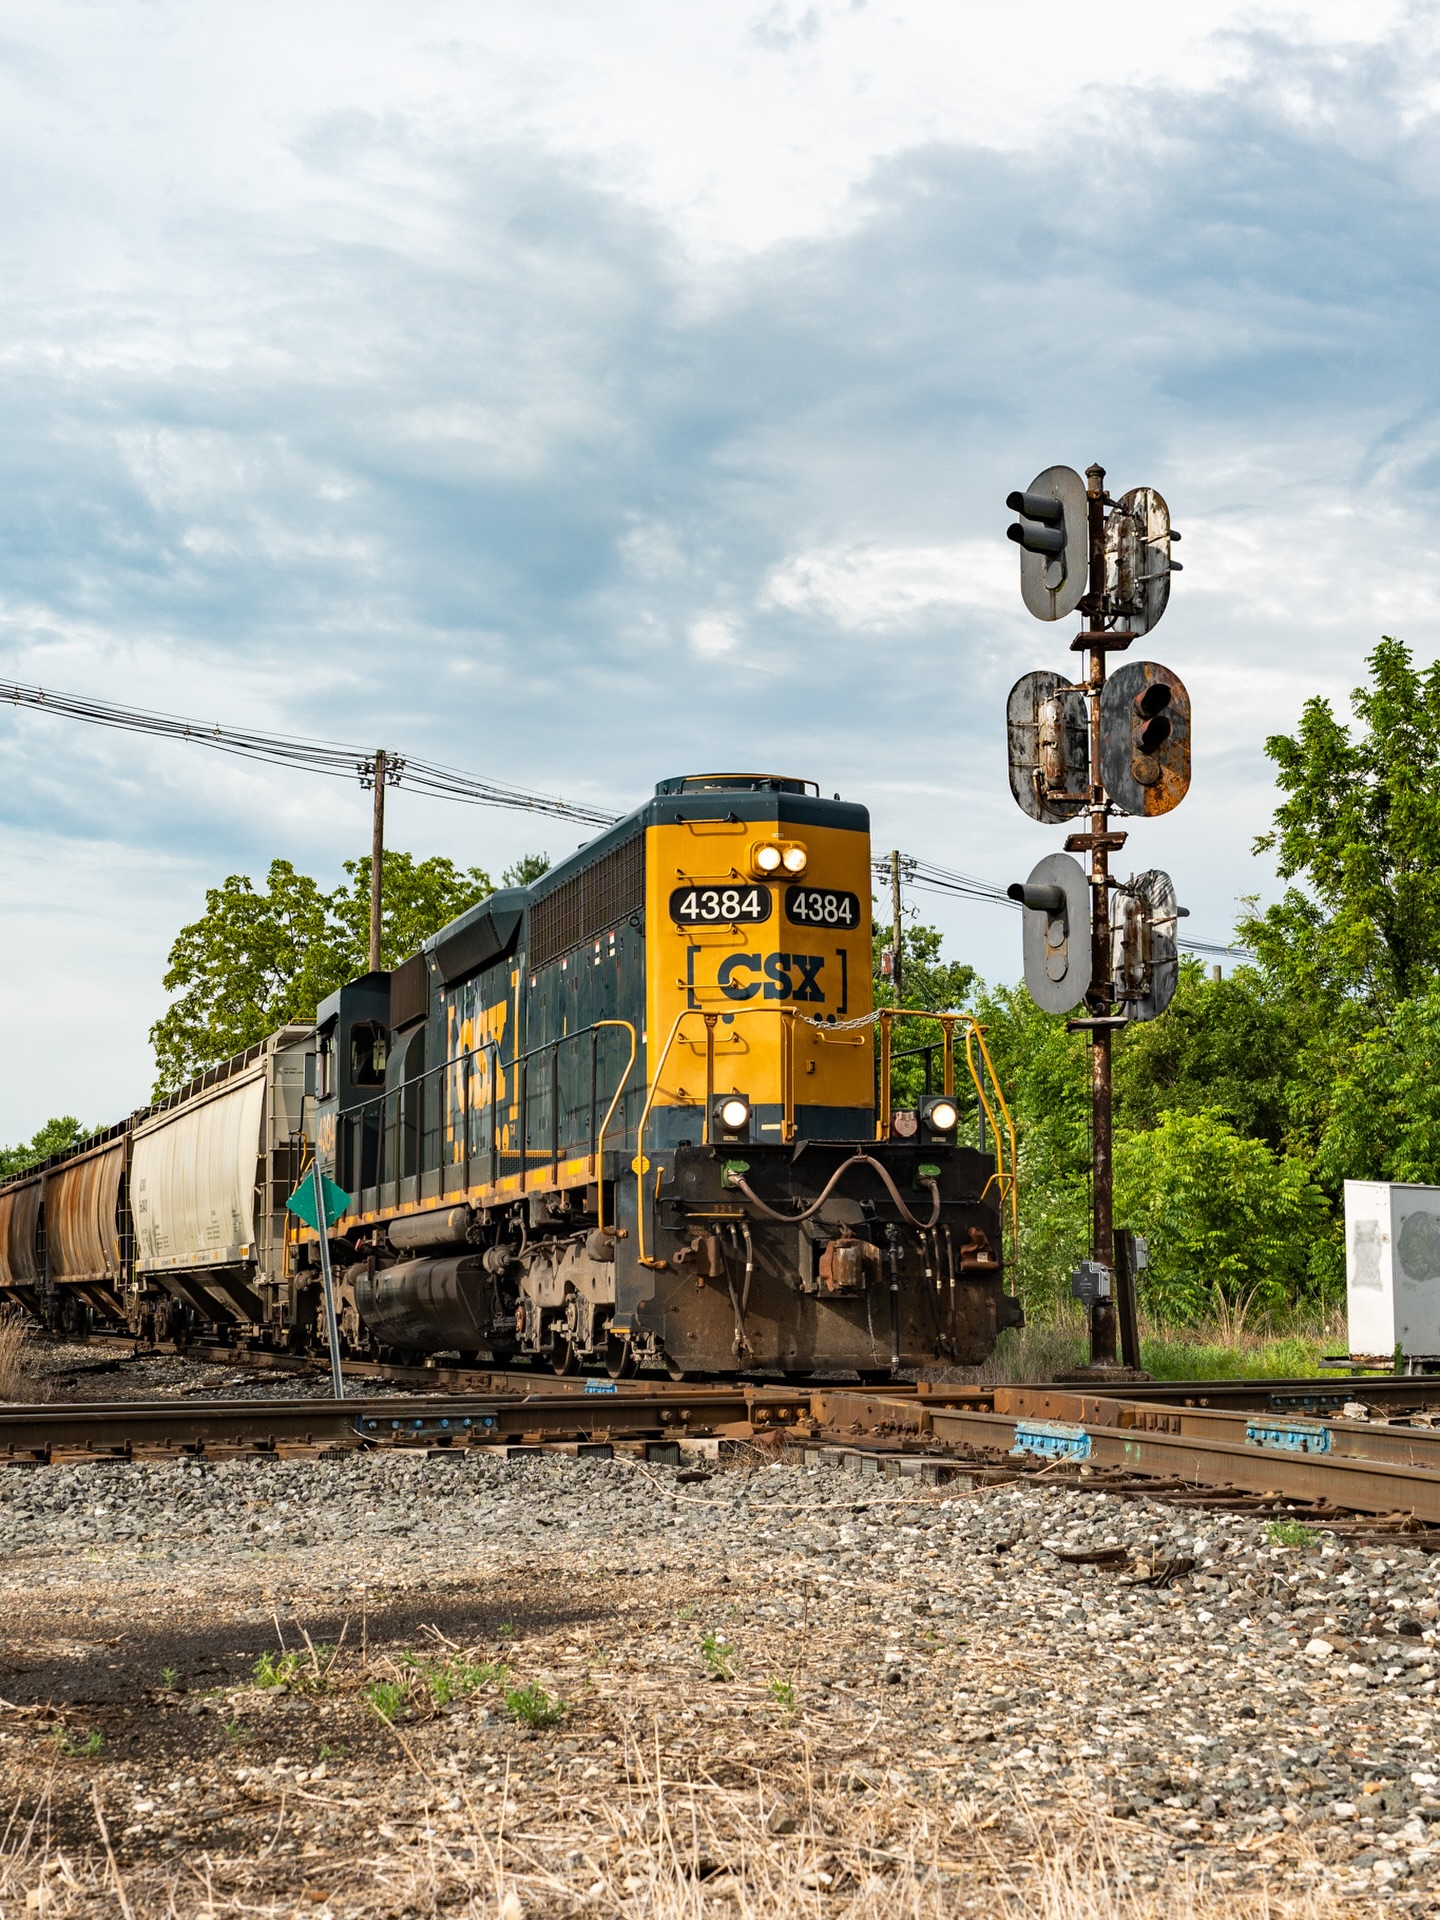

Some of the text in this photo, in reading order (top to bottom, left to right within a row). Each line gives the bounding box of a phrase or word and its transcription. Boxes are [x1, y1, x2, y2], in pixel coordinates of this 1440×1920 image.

[679, 890, 761, 920] 4384
[792, 892, 853, 924] 4384
[717, 952, 826, 1003] CSX
